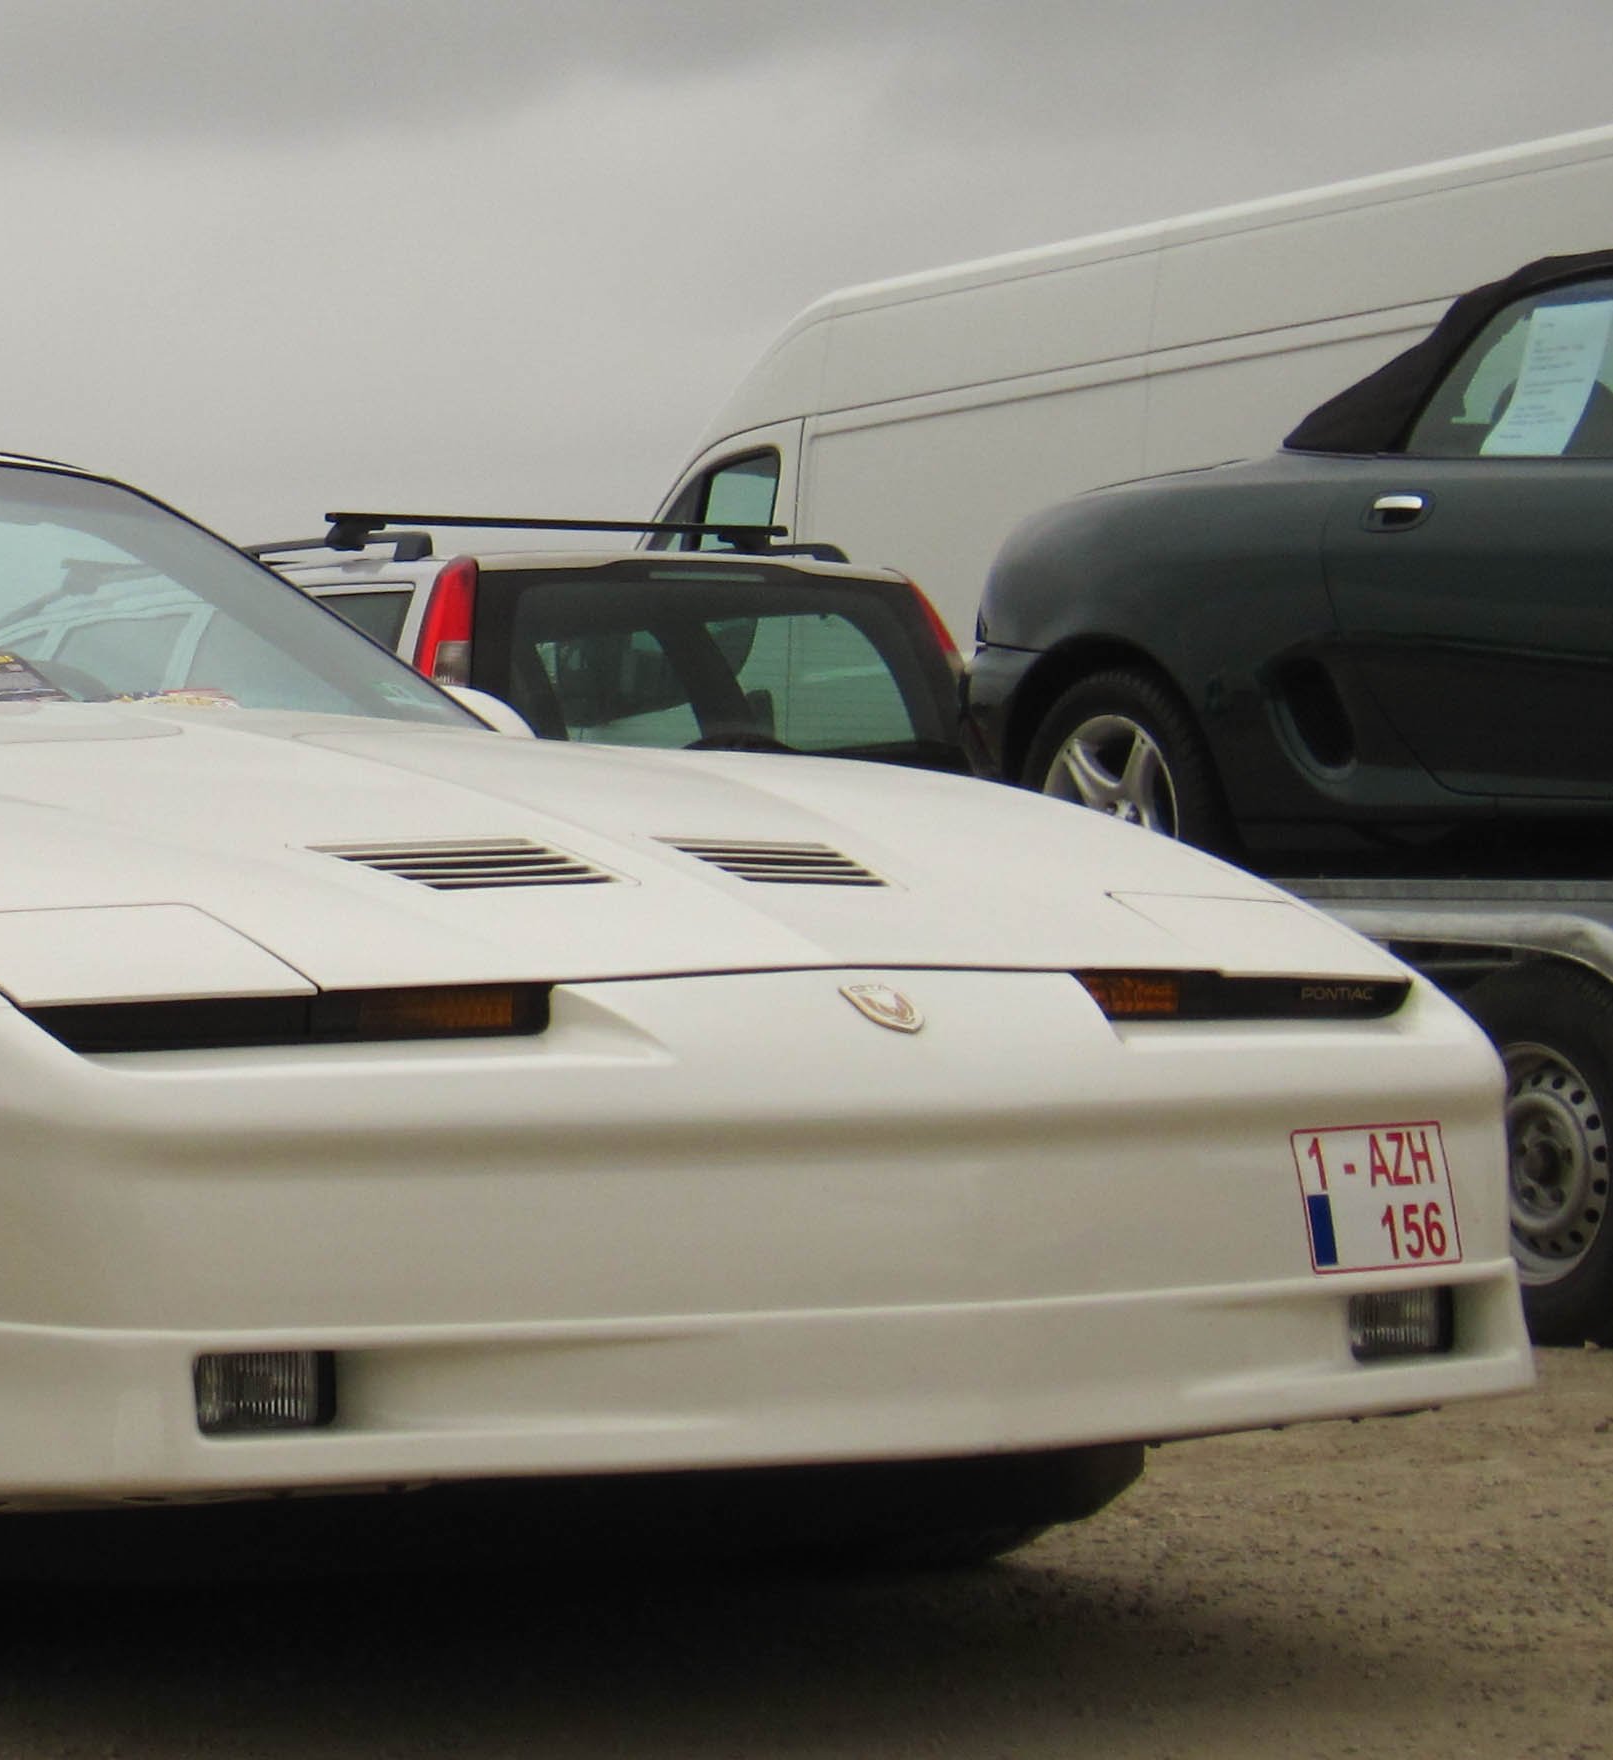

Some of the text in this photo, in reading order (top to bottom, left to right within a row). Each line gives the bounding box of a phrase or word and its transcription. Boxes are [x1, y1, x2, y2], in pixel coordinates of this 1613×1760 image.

[1301, 986, 1373, 1001] PONTIAC
[1368, 1131, 1436, 1188] AZH
[1381, 1202, 1447, 1260] 156
